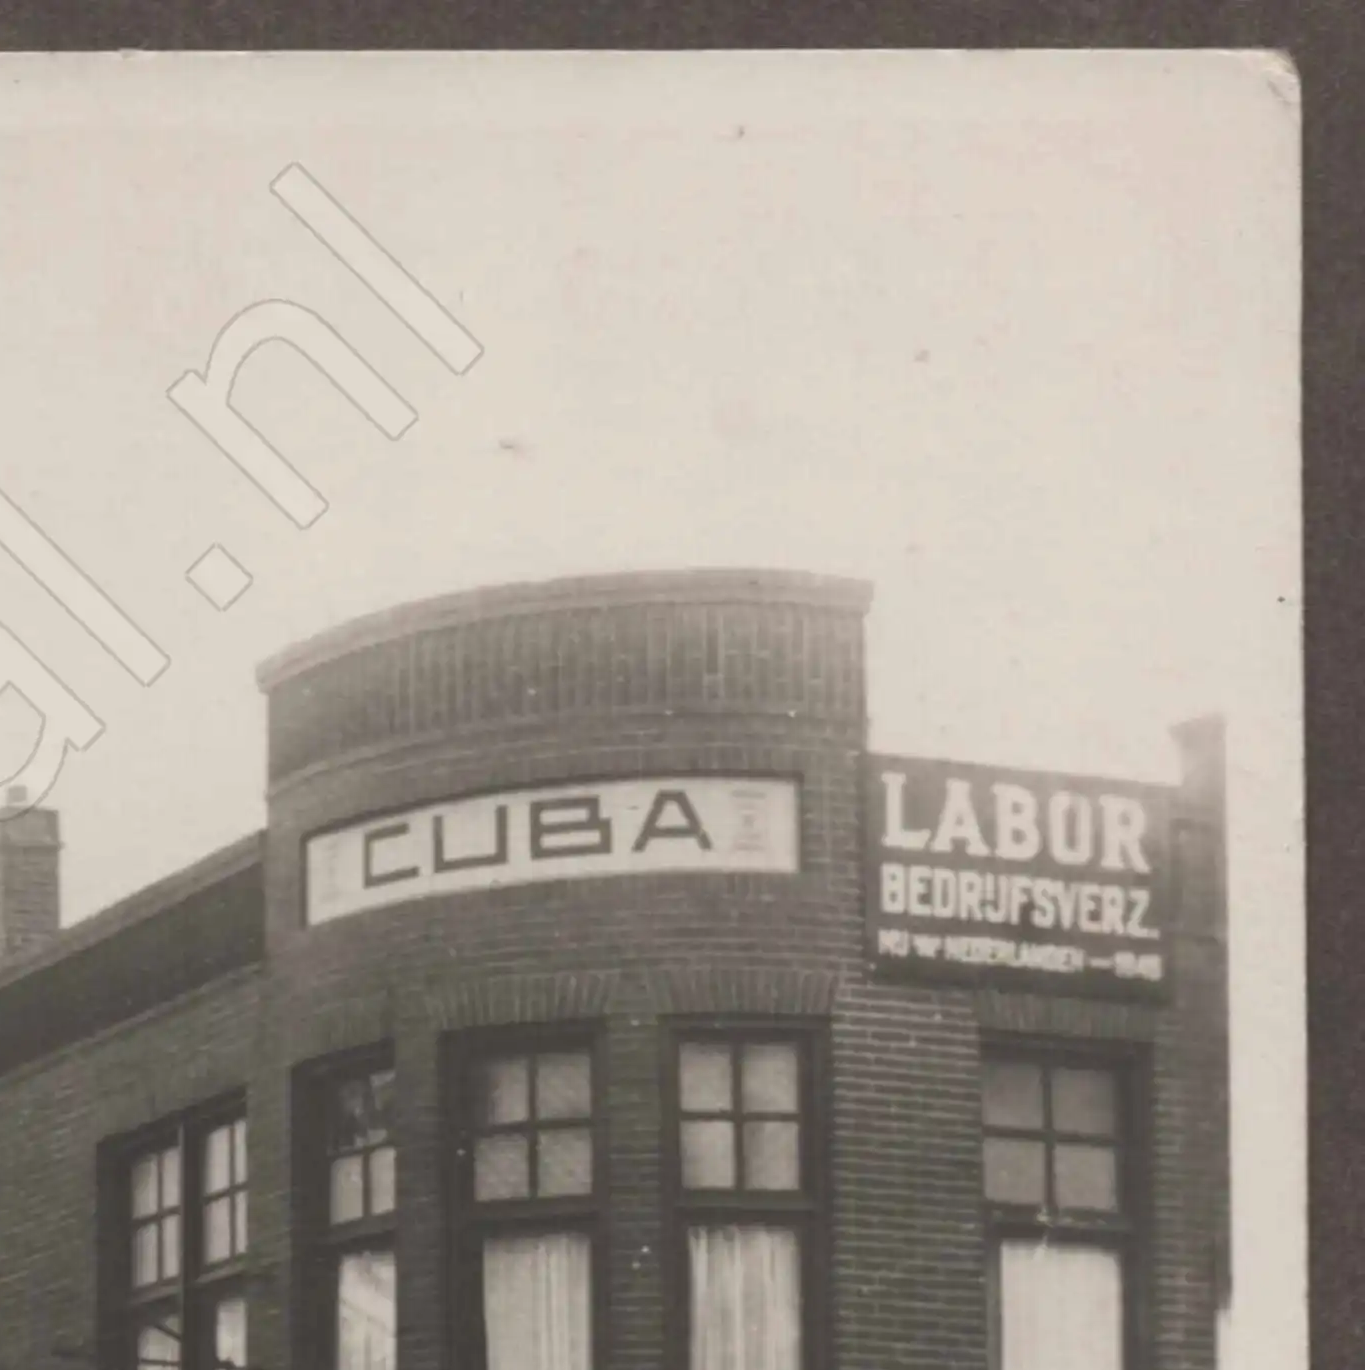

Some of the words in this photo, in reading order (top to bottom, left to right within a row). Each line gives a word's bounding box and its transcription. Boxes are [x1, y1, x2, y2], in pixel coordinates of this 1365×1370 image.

[364, 789, 713, 889] CUBA
[881, 771, 1152, 874] LABOR
[880, 862, 1160, 940] BEDRIJFSVERZ.
